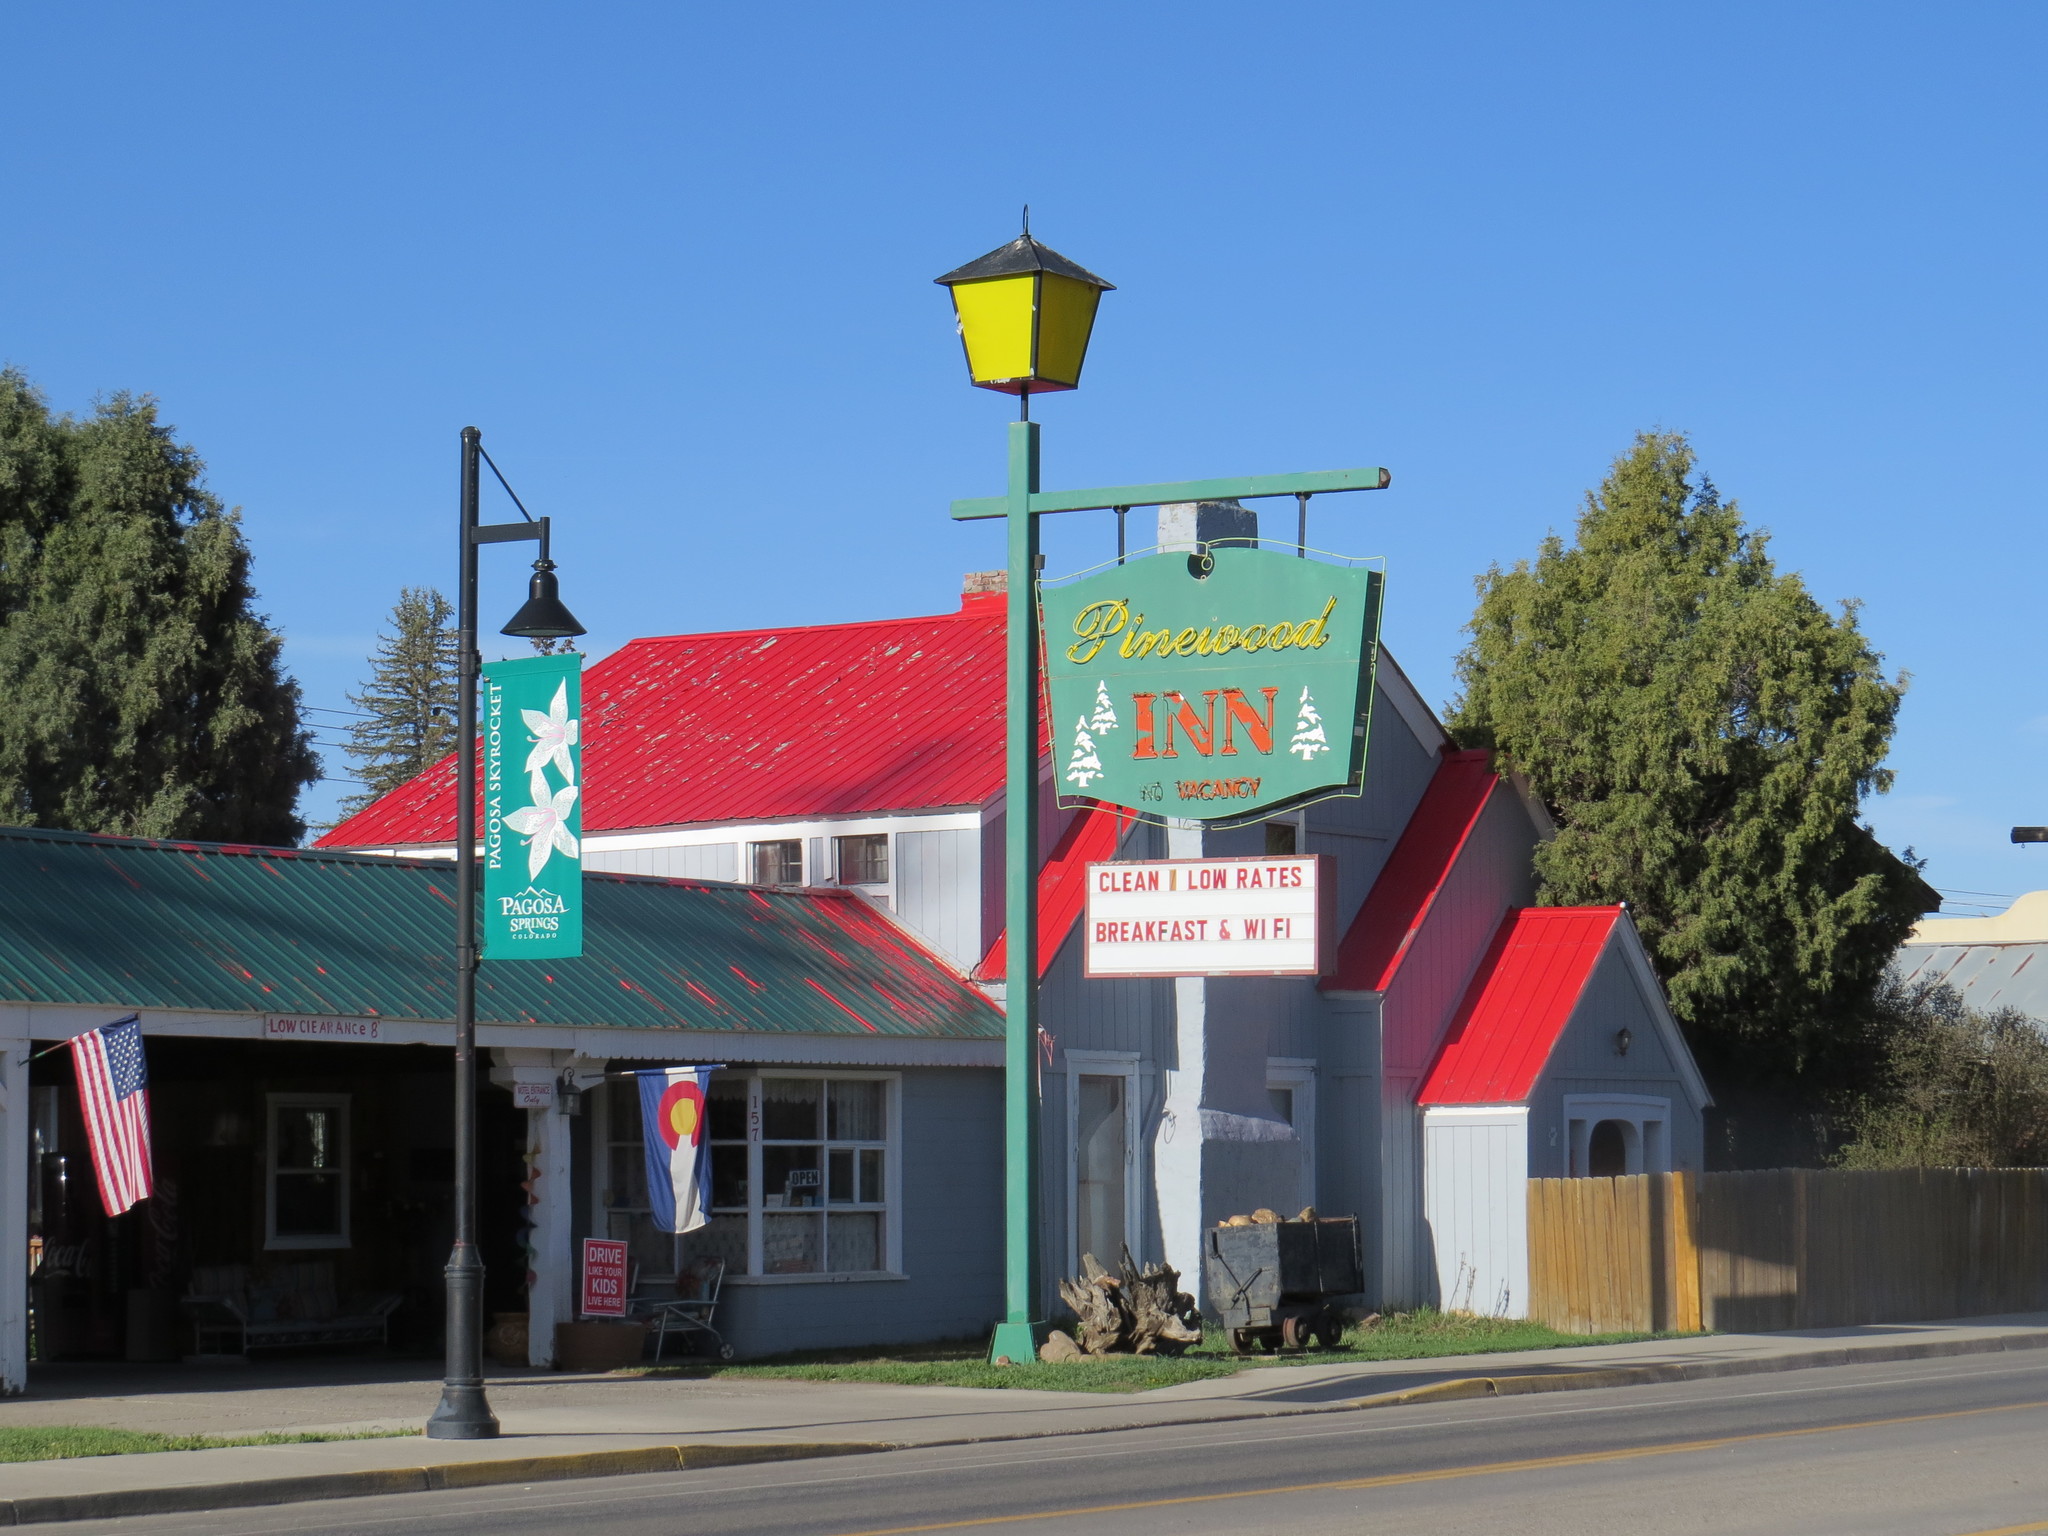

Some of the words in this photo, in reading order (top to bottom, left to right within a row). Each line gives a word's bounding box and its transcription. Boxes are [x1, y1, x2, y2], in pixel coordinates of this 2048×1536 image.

[1066, 595, 1337, 664] Pinewood
[1132, 687, 1278, 759] INN
[489, 683, 502, 791] SKYROCKET
[1140, 782, 1163, 801] NO
[1176, 777, 1261, 800] VACANCY
[489, 797, 502, 869] PAGOSA
[1099, 870, 1159, 892] CLEAN
[1188, 869, 1227, 890] LOW
[1237, 866, 1302, 889] RATES
[497, 894, 571, 915] PAGOSA
[510, 917, 559, 934] SPRINGS
[1096, 919, 1208, 942] BREAKFAST
[1219, 919, 1231, 940] &
[269, 1019, 297, 1033] LOW
[792, 1171, 818, 1185] OPEN
[589, 1247, 622, 1264] DRIVE
[588, 1267, 603, 1276] LIKE
[605, 1267, 622, 1276] YOUR
[592, 1278, 618, 1295] KIDS
[588, 1296, 603, 1306] LIVE
[604, 1297, 621, 1307] HERE
